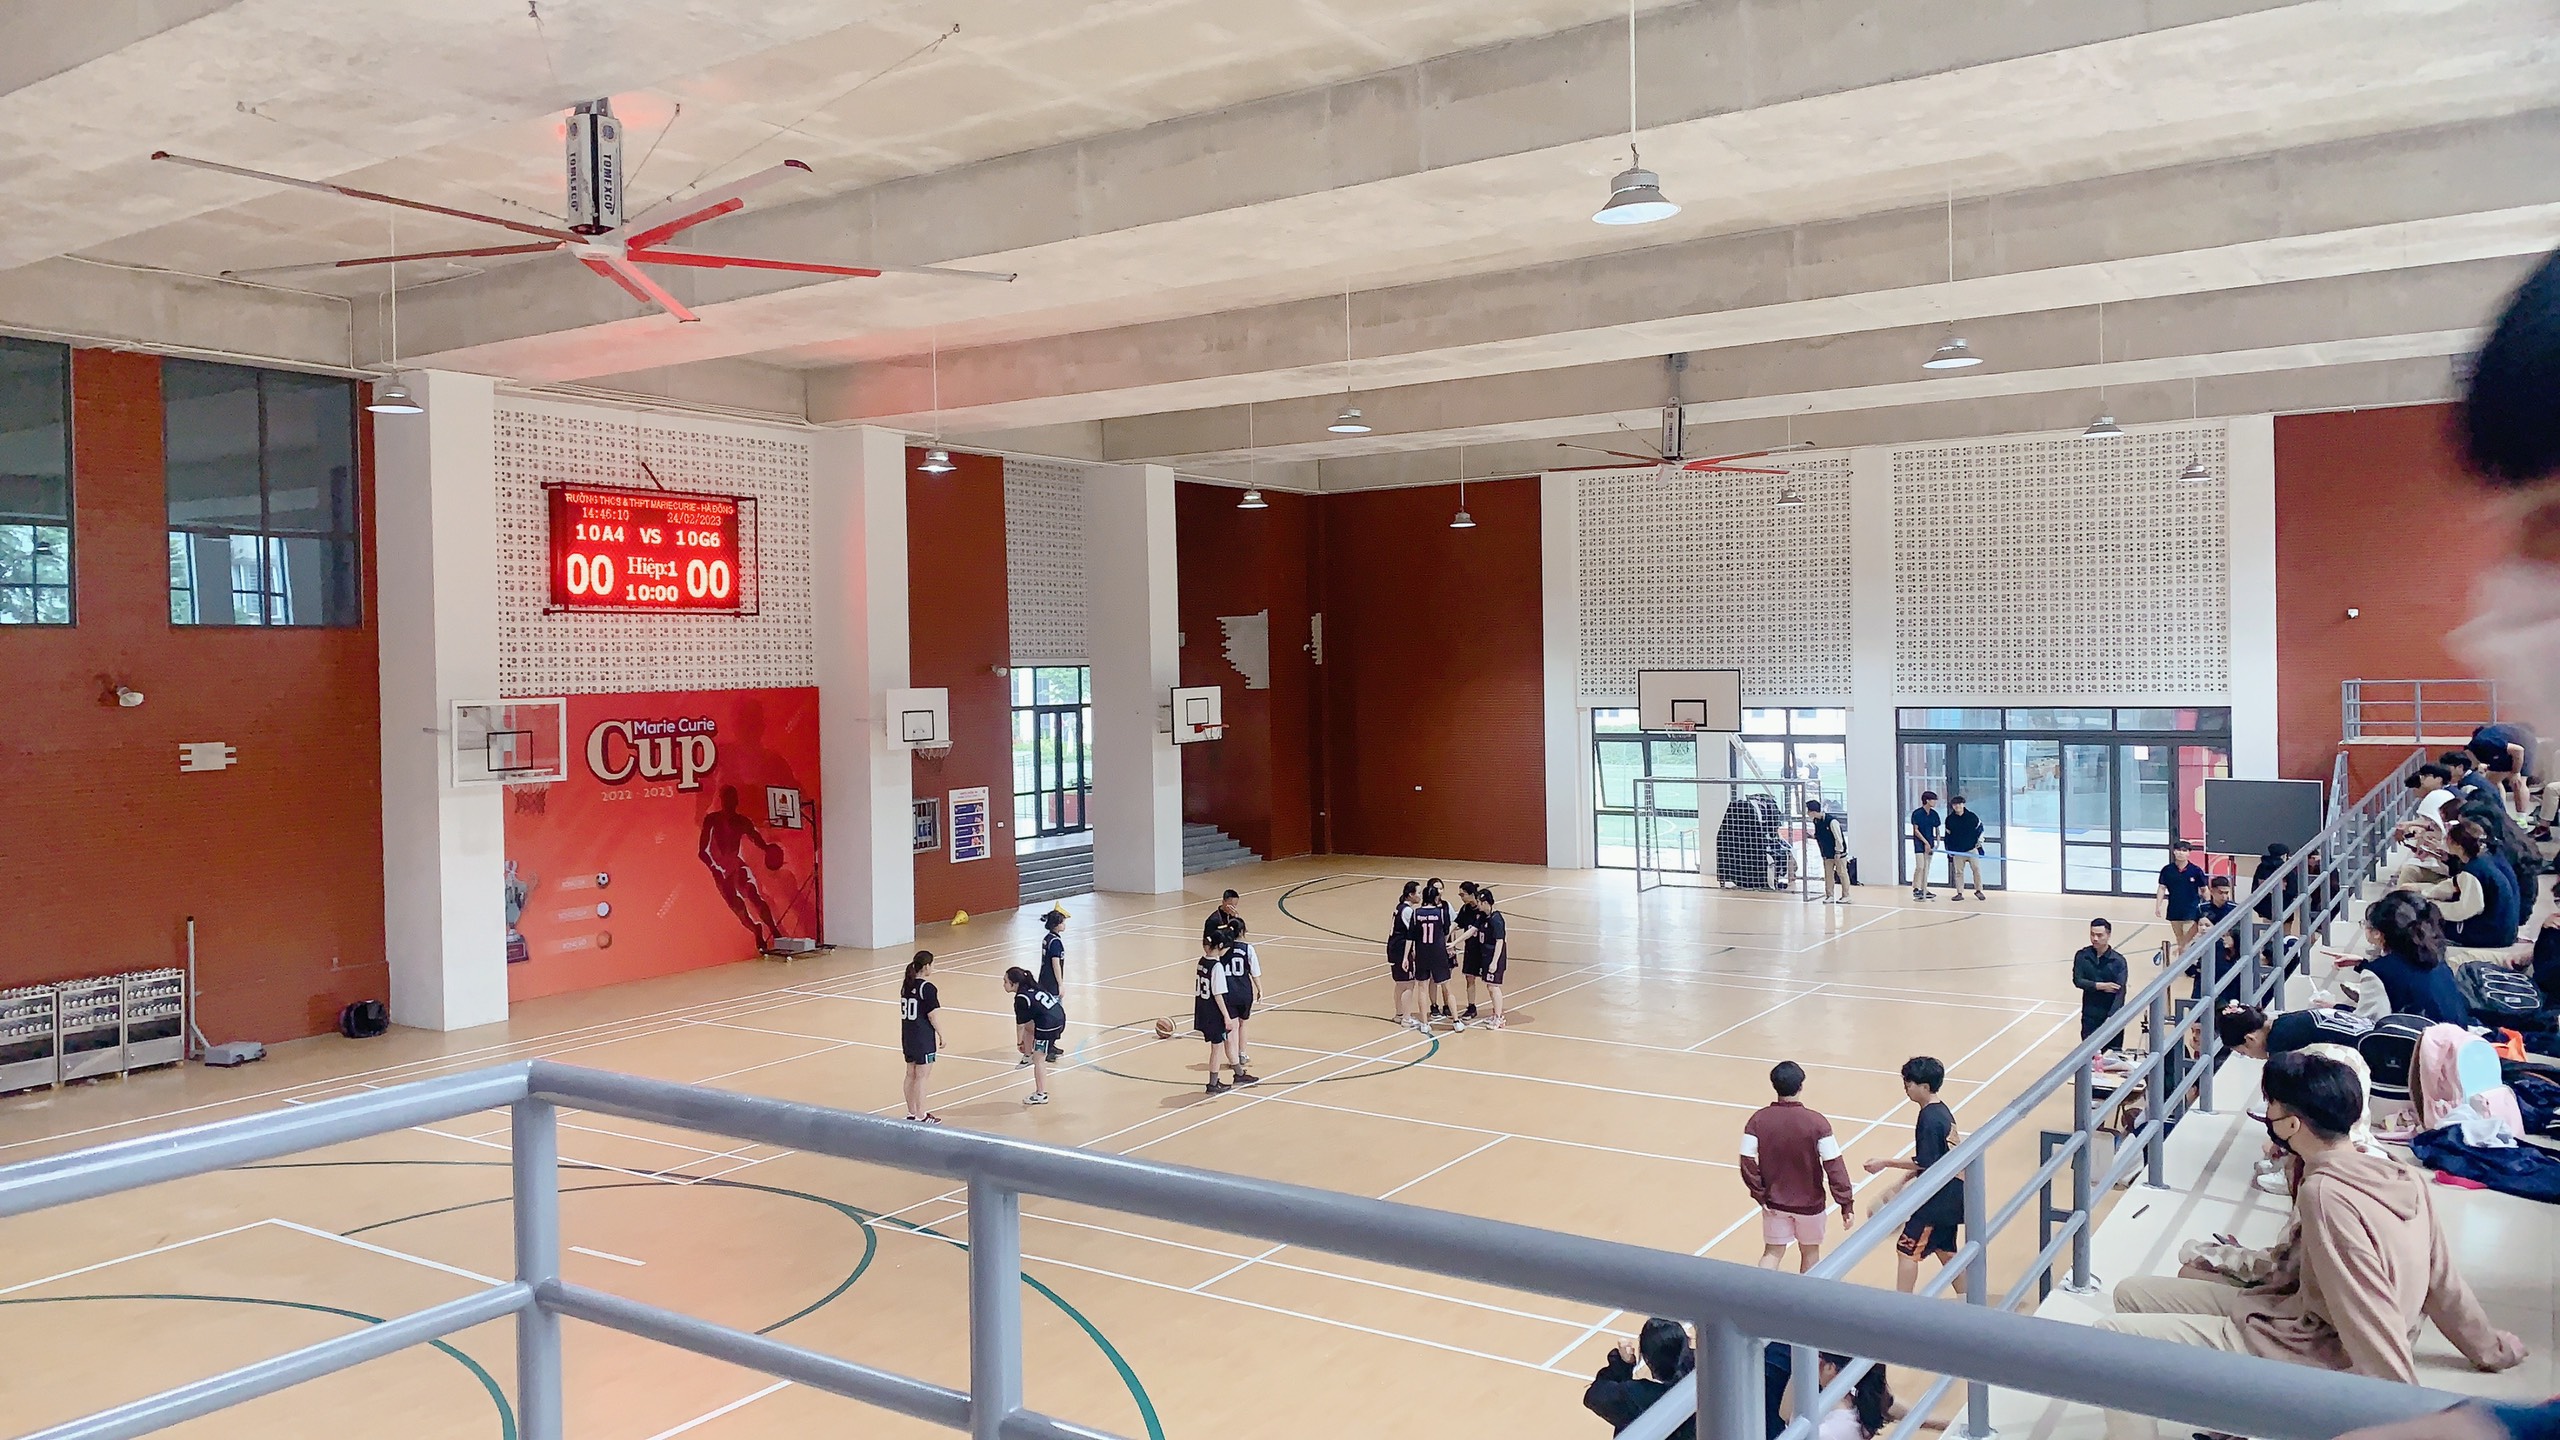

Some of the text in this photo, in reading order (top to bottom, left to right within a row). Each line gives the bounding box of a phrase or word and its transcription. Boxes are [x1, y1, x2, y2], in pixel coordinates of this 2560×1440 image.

[603, 154, 613, 210] TOMEXCO
[600, 495, 621, 506] THCS
[623, 497, 628, 507] &
[629, 498, 650, 509] THPT
[701, 502, 712, 513] HÀ
[582, 507, 722, 526] 14:46:10 24/02/2023
[575, 523, 721, 547] 10A4 VS 10G6
[566, 553, 615, 595] 00
[627, 556, 679, 580] Hiệp:1
[686, 558, 730, 599] 00
[625, 584, 679, 602] 10:00
[634, 718, 715, 735] Marie Curie
[587, 721, 716, 789] Cup
[600, 790, 632, 801] 2022
[643, 786, 674, 798] 2023
[1421, 923, 1434, 943] 11
[1225, 957, 1245, 976] 10
[900, 997, 918, 1021] 30
